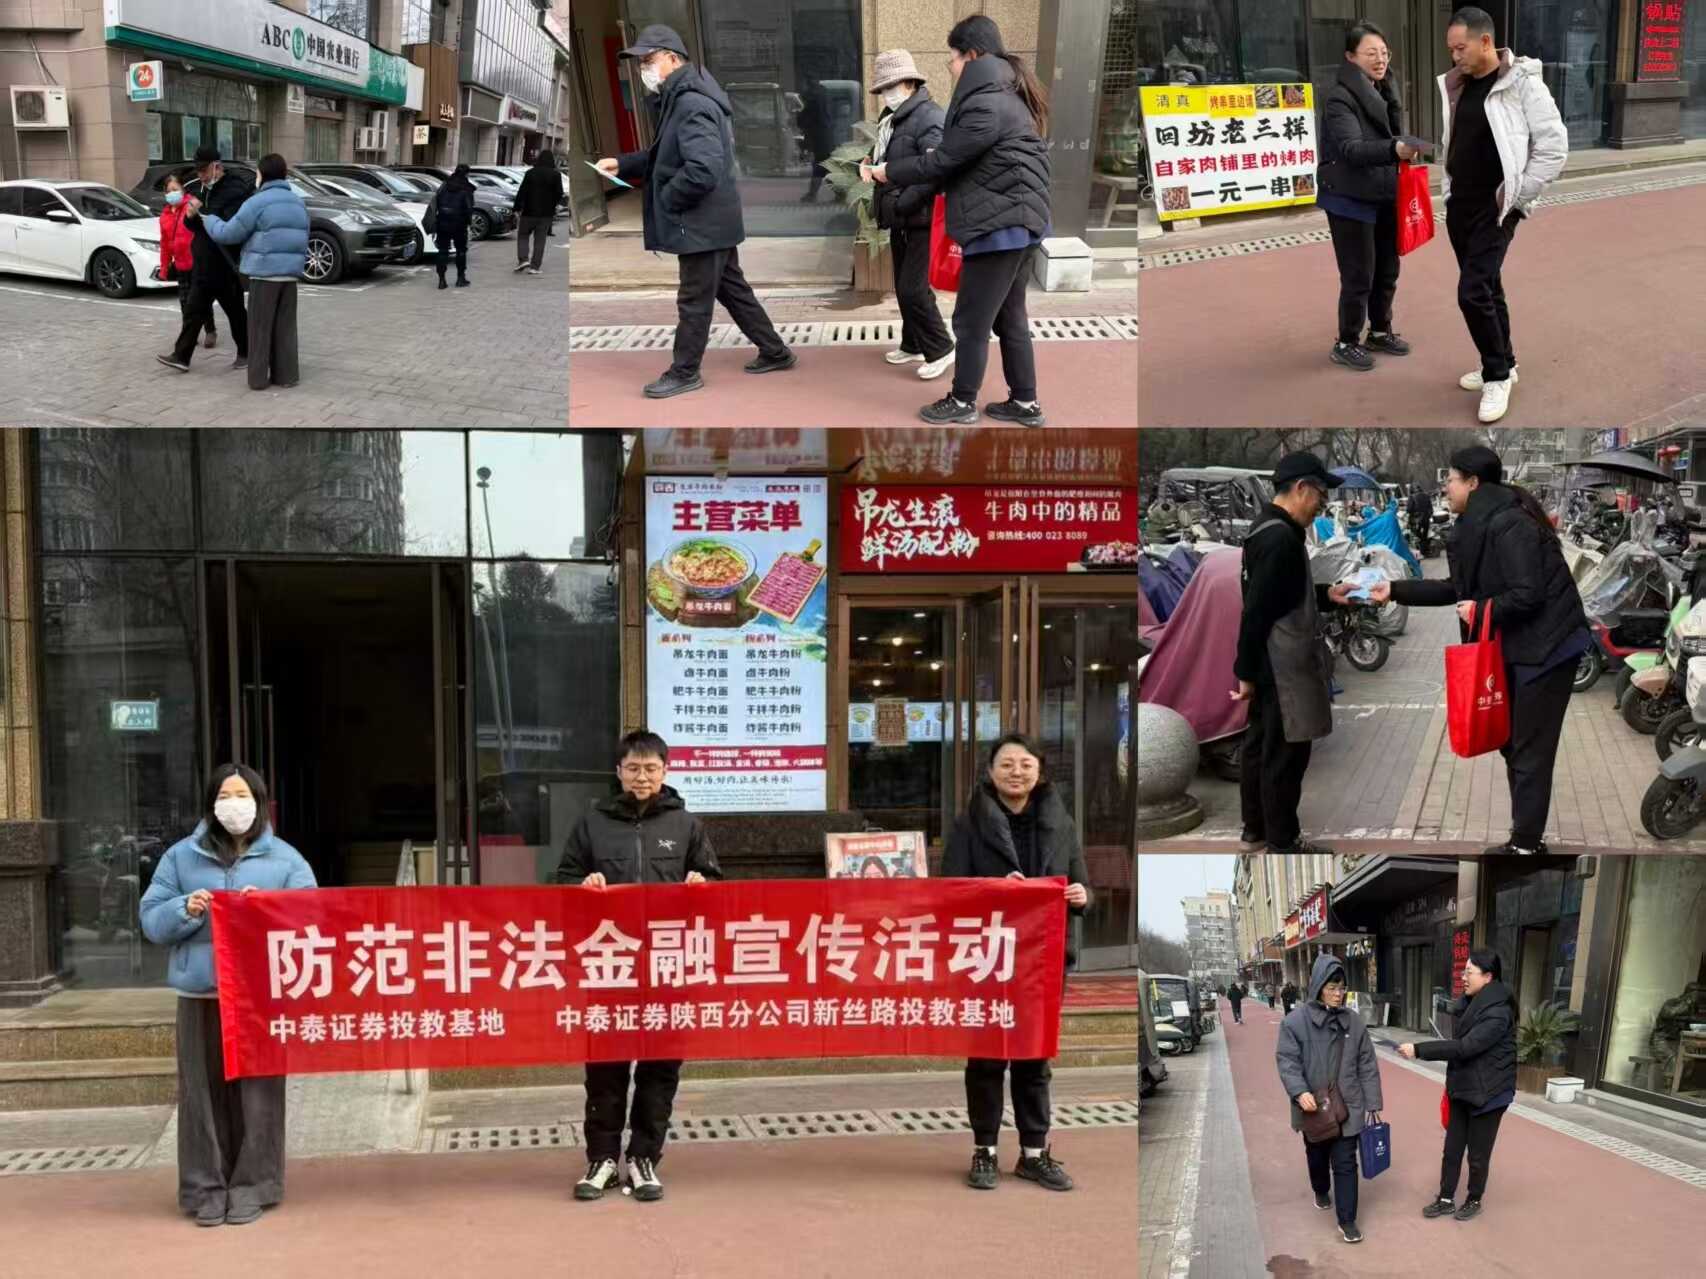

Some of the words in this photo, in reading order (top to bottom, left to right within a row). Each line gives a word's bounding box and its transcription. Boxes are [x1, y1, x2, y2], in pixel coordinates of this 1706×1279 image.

[261, 23, 290, 50] ABC
[307, 33, 360, 70] 中国农业银行
[1156, 94, 1189, 108] 清真
[1155, 115, 1308, 147] 回坊老三样
[1155, 149, 1314, 177] 自家肉铺里的烤肉
[1191, 176, 1291, 203] 一元一串
[672, 500, 802, 532] 主营菜单
[984, 500, 1121, 522] 牛肉中的精品
[673, 649, 728, 659] 吊龙牛肉面
[746, 649, 801, 659] 吊龙牛肉粉
[684, 668, 728, 678] 卤牛肉面
[746, 668, 790, 678] 卤牛肉粉
[266, 911, 1017, 1001] 防范非法金融宣传活动
[269, 1007, 506, 1044] 中泰证券投教基地
[556, 997, 1016, 1034] 中泰证券陕西分公司新丝路投教基地
